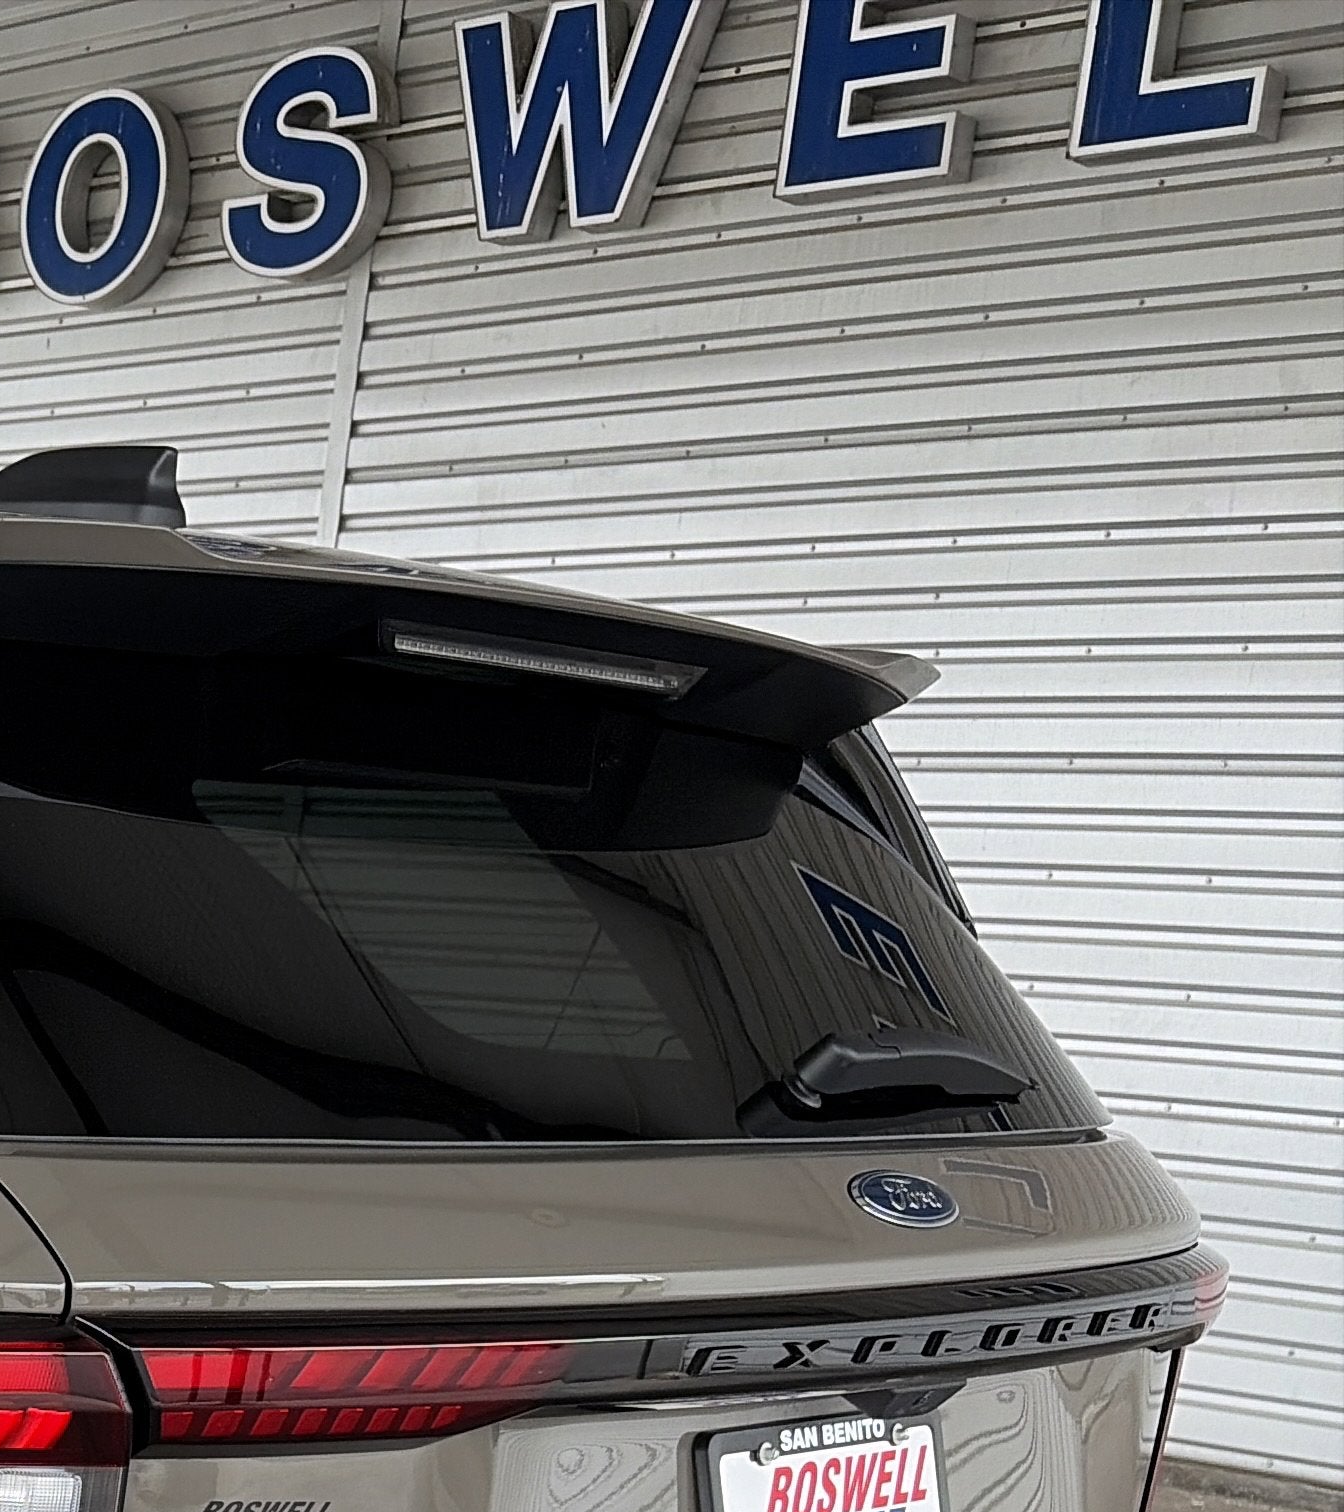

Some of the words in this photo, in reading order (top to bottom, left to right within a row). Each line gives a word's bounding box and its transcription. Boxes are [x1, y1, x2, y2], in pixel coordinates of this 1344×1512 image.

[882, 1176, 943, 1211] Ford
[685, 1302, 1162, 1377] EXPLORER
[780, 1427, 818, 1452] SAN
[822, 1418, 886, 1445] BENITO
